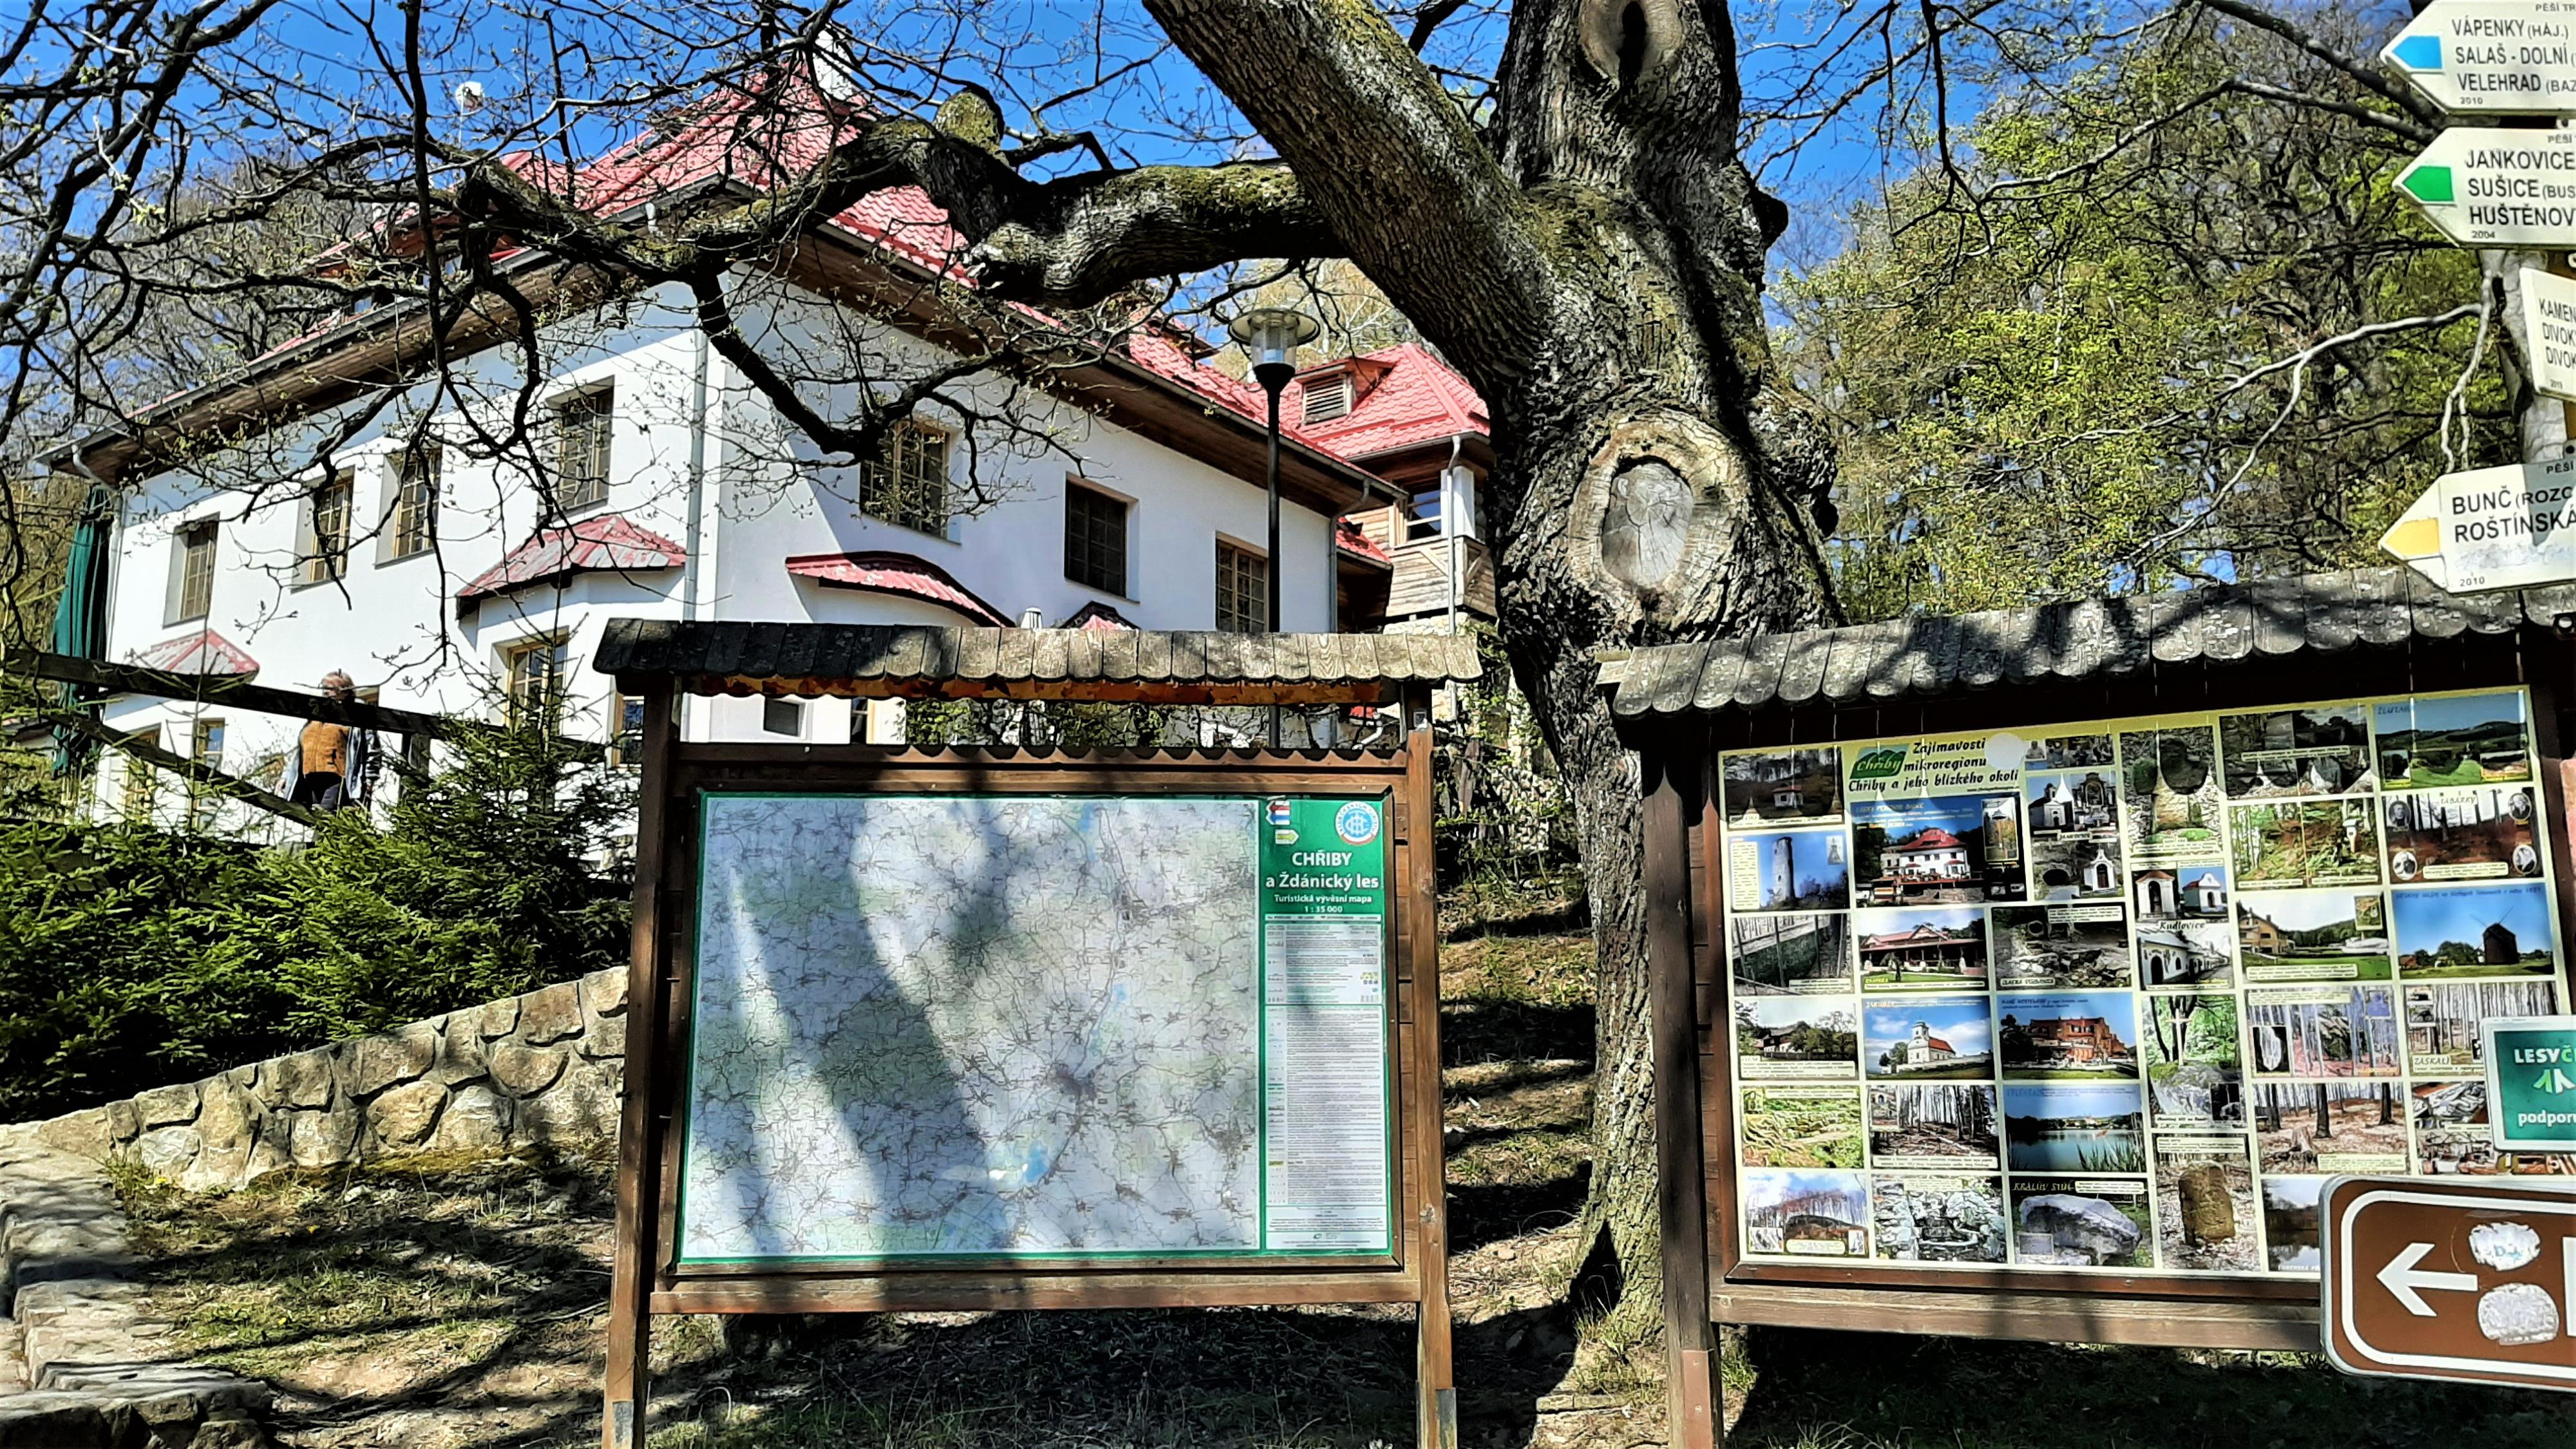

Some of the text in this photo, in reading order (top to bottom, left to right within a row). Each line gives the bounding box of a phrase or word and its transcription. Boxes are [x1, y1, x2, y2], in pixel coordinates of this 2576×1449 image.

[2452, 15, 2524, 37] VÁPENKY
[2456, 43, 2507, 64] SALAŠ
[2520, 43, 2568, 64] DOLNÍ
[2458, 73, 2541, 91] VELEHRAD
[2466, 149, 2576, 170] JANKOVICE
[2468, 174, 2541, 198] SUŠICE
[2542, 321, 2576, 347] DIVOK
[2452, 485, 2512, 515] BUNČ
[2459, 576, 2485, 587] 2010
[1904, 757, 1987, 772] mikroregionu
[1849, 779, 1886, 793] Chřiby
[1891, 781, 1899, 789] a
[1904, 775, 1929, 791] jeho
[1935, 772, 1984, 786] blízkého
[1292, 849, 1352, 866] CHŘIBY
[1265, 871, 1379, 891] a Ždánický les
[1274, 894, 1314, 902] Turistická
[1349, 896, 1372, 904] mapa
[2159, 921, 2205, 930] Kudlovice
